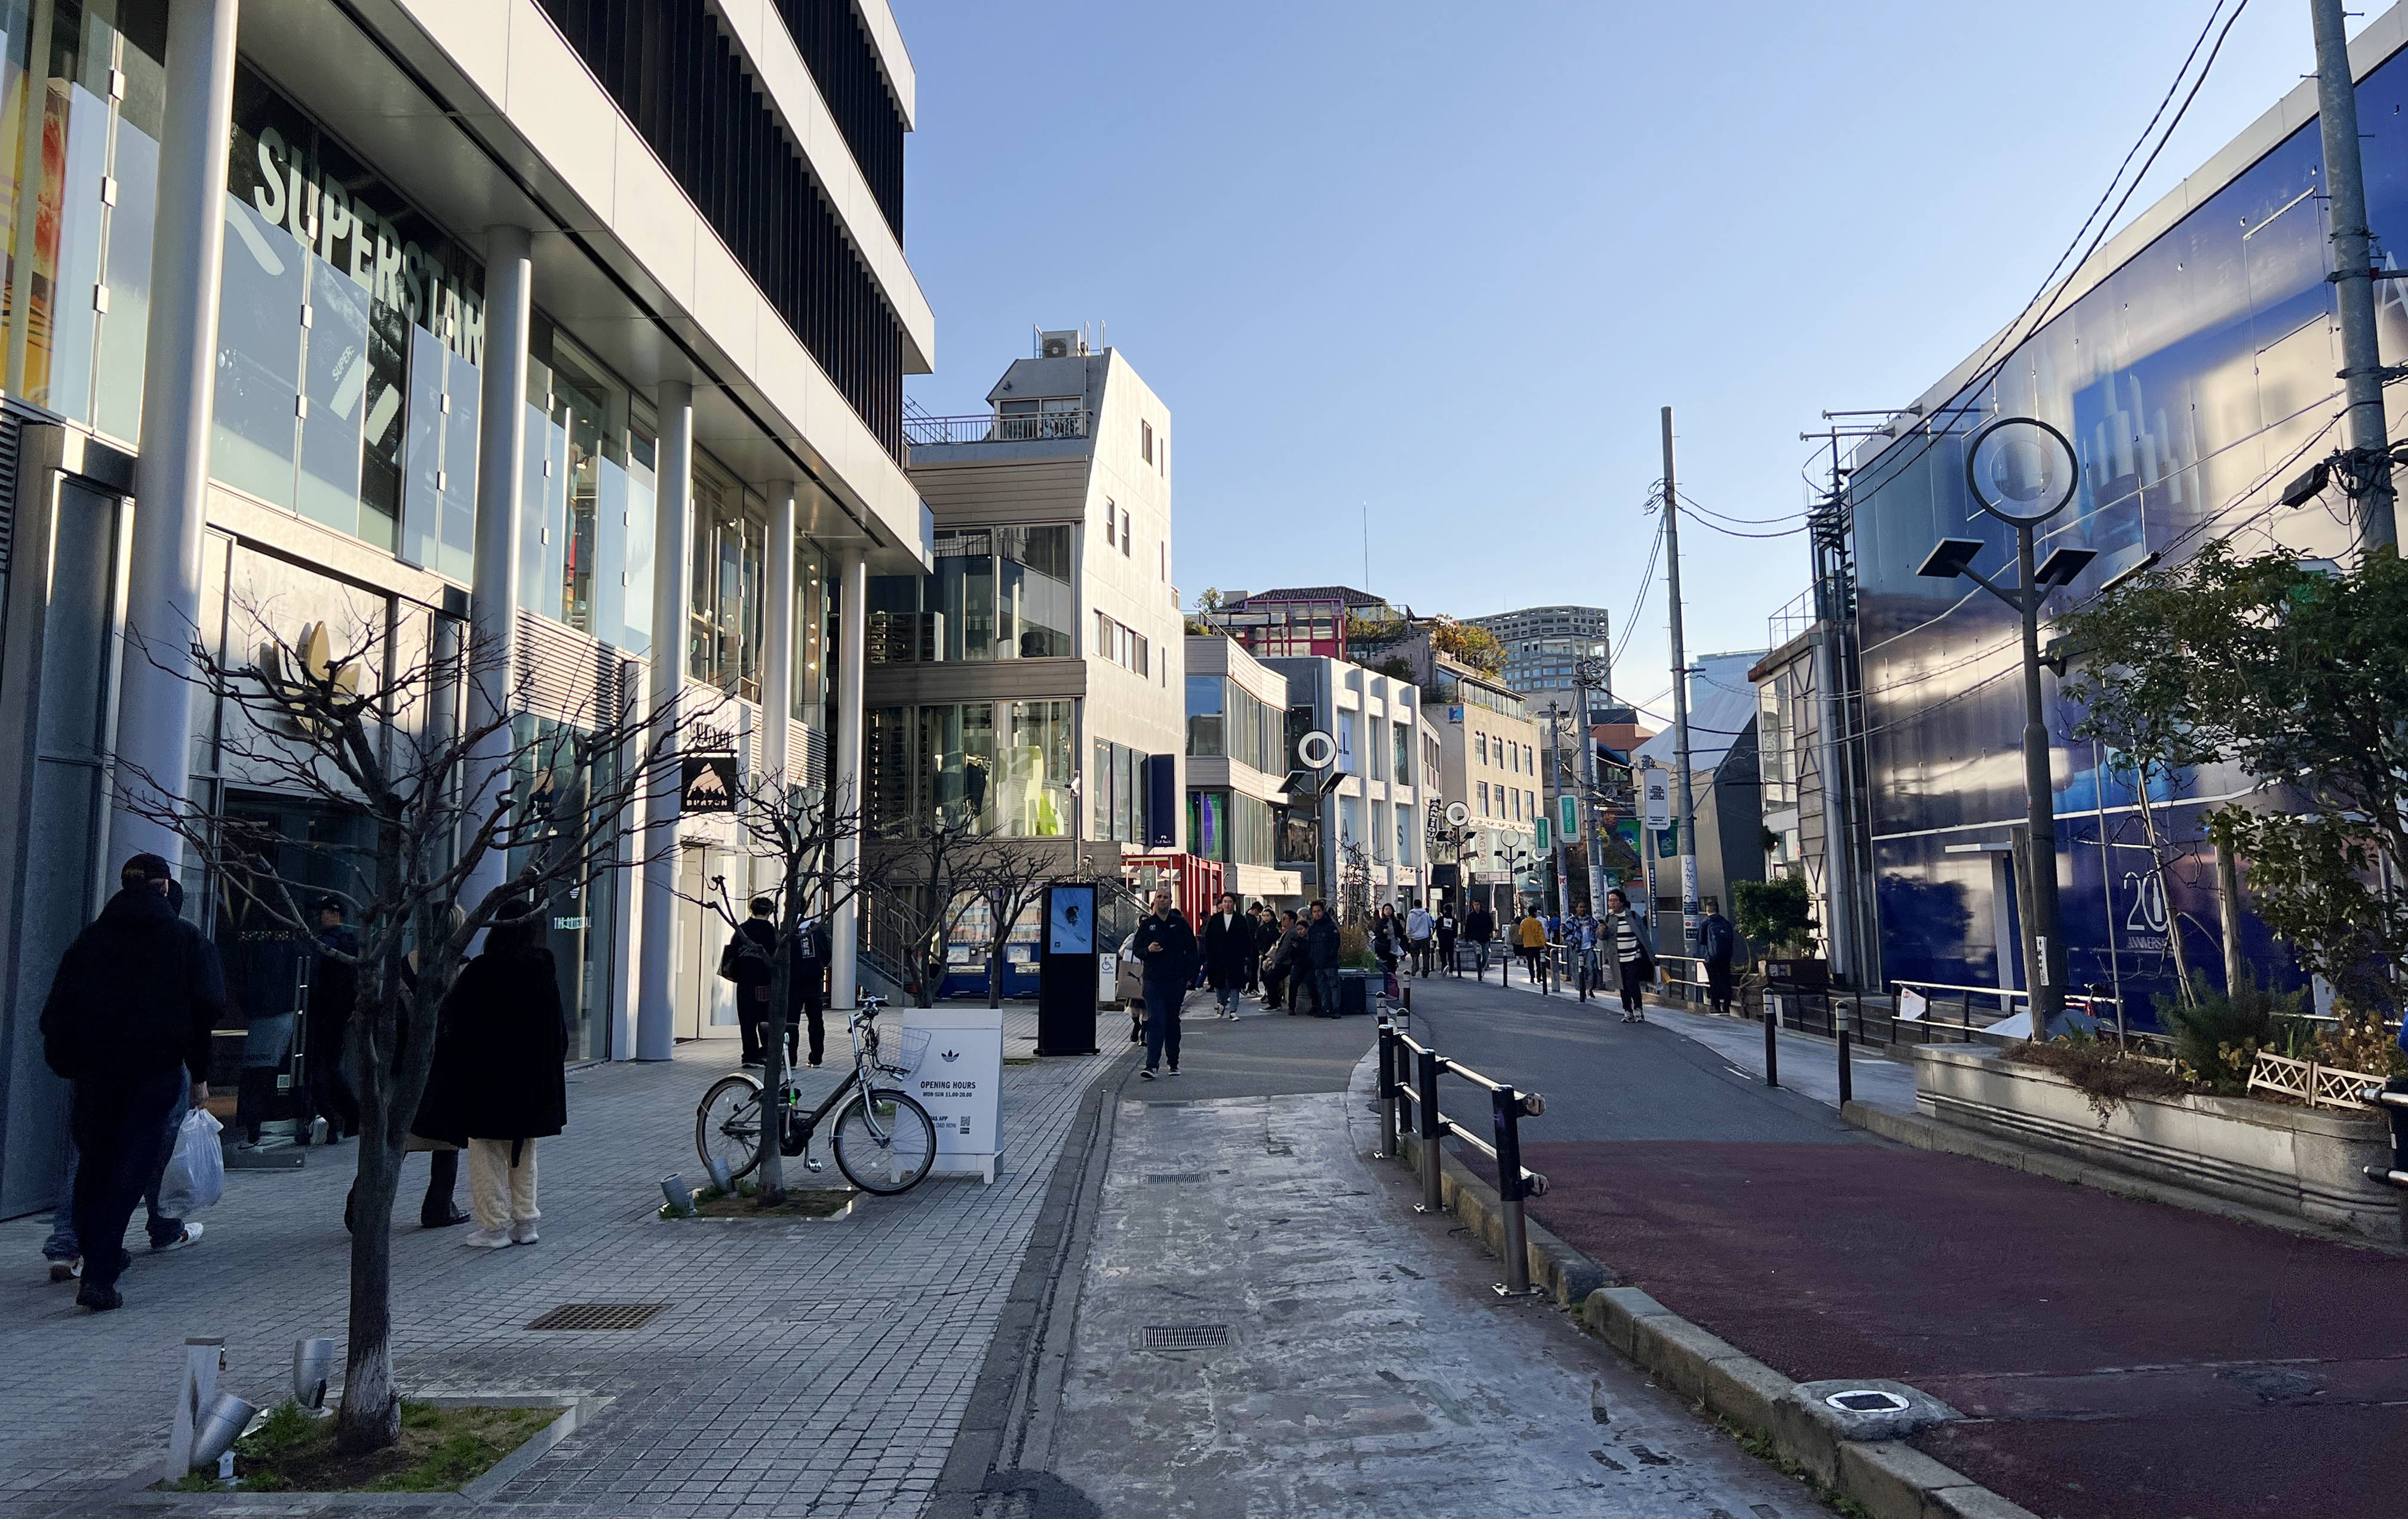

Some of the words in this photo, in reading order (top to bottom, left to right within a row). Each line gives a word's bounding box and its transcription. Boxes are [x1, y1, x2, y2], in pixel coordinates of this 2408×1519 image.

[254, 127, 485, 371] SUPERSTAR
[1427, 806, 1439, 848] ANTIQUES
[1478, 829, 1486, 865] RAGTAG
